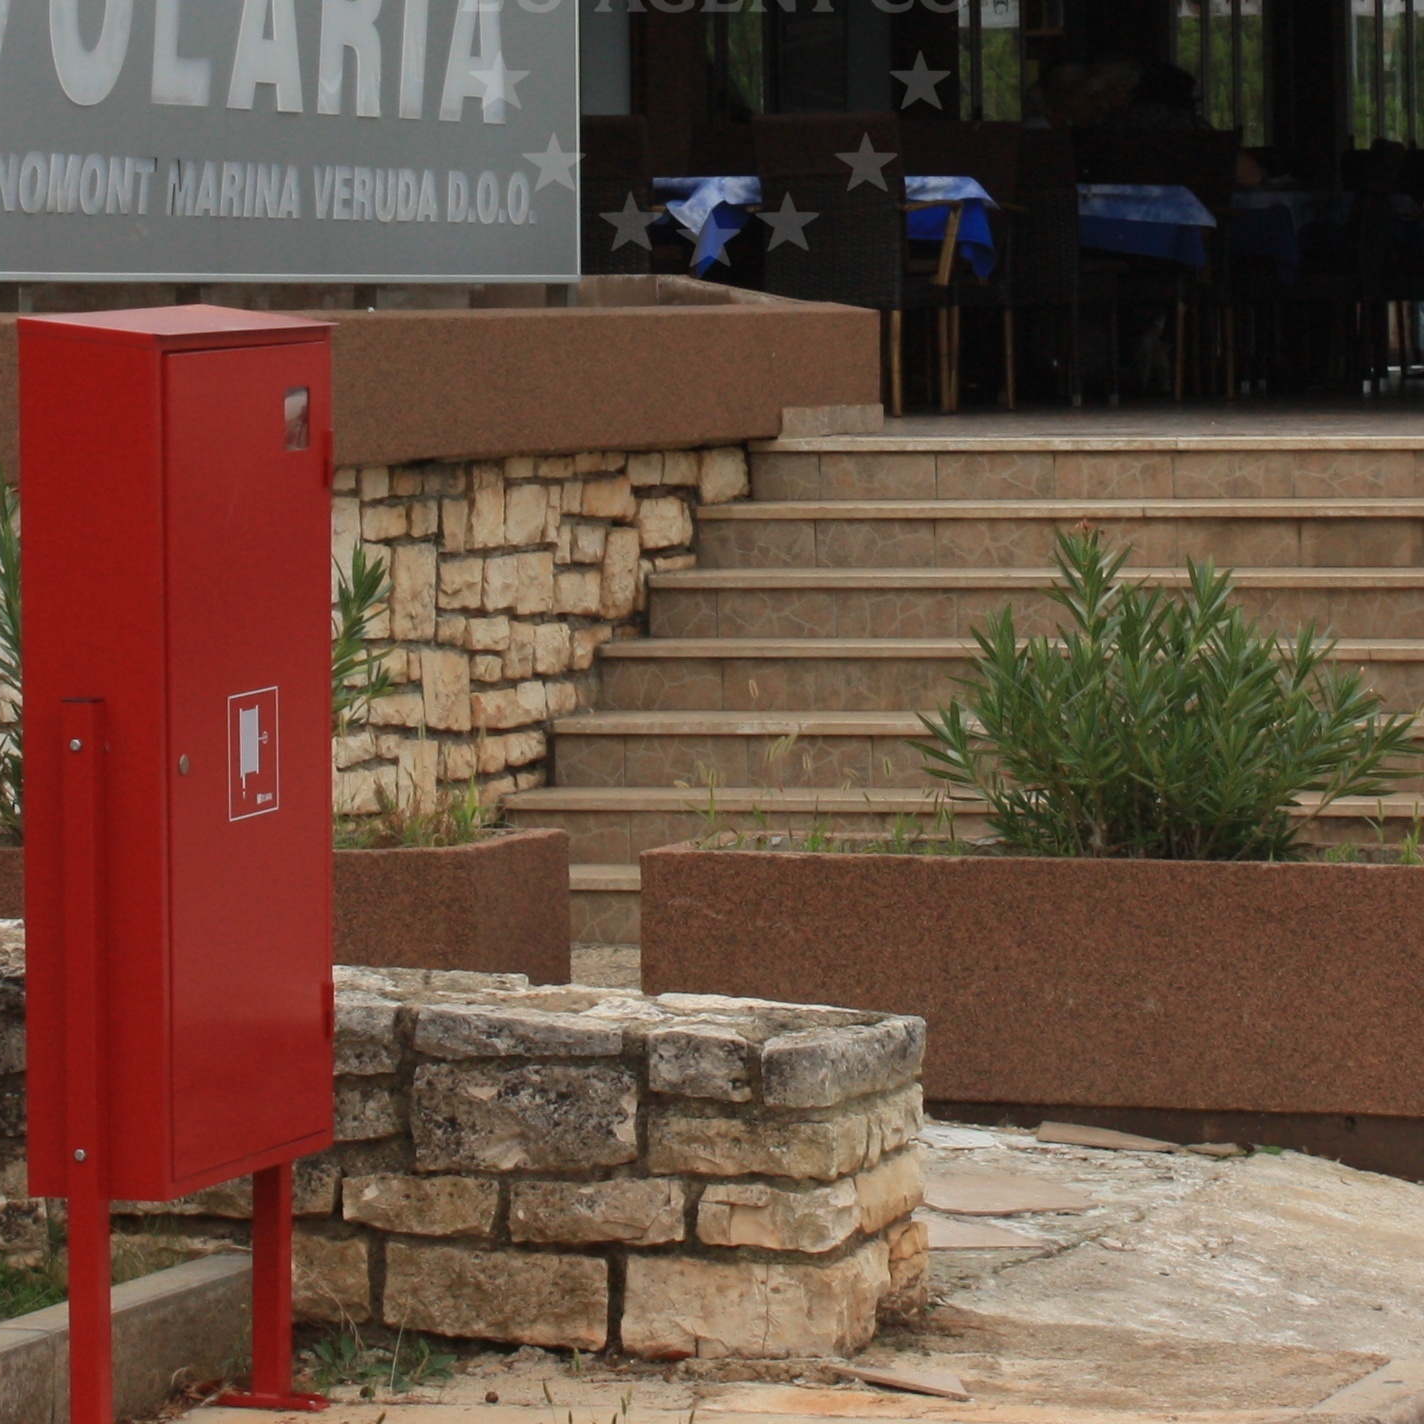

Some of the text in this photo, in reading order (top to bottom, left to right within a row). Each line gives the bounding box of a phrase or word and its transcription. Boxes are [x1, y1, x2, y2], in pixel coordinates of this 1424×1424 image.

[169, 158, 302, 220] MARINA
[313, 165, 439, 224] VERUDA
[447, 171, 538, 226] D.O.O.
